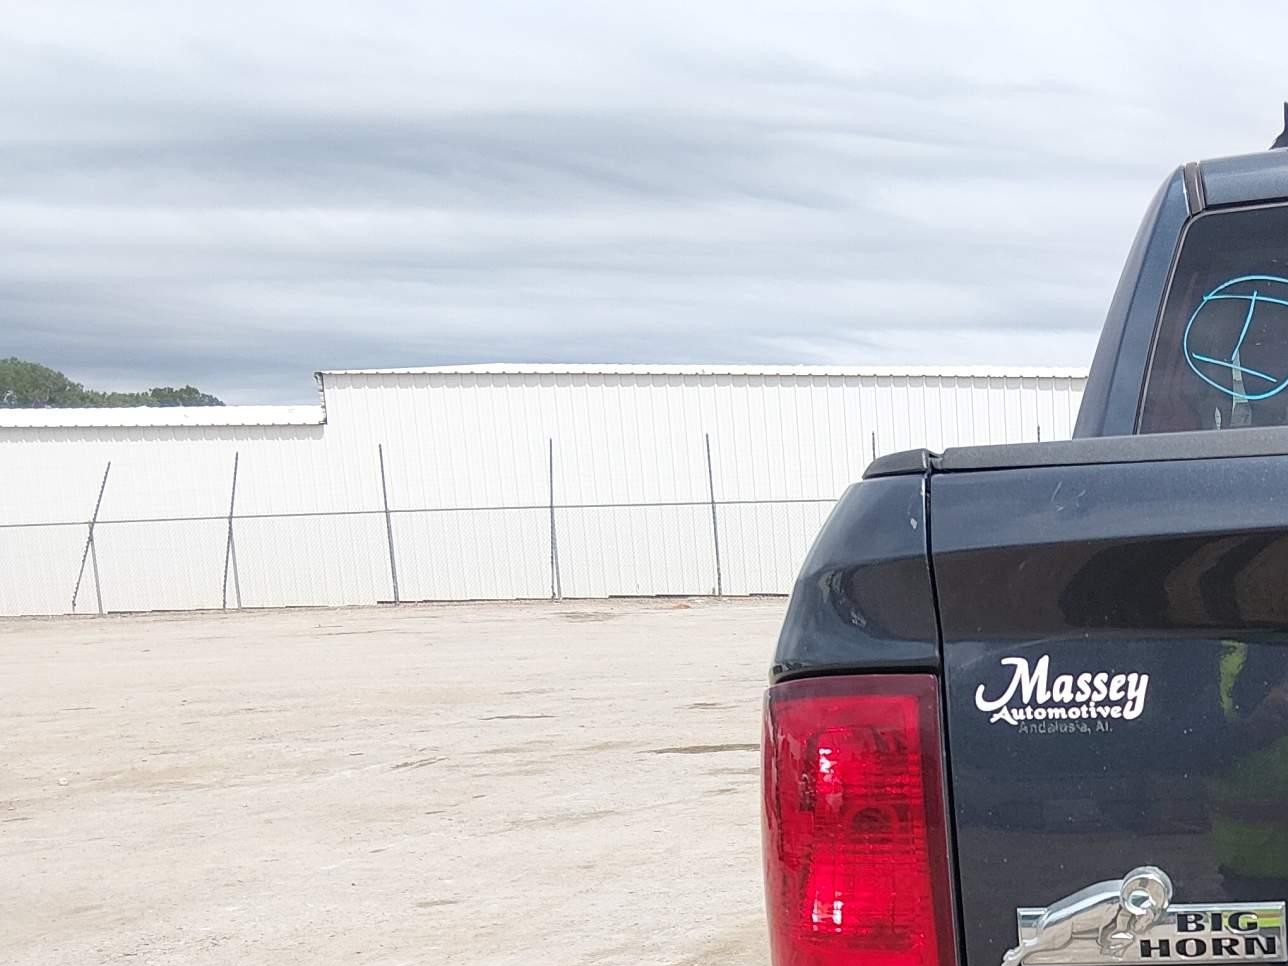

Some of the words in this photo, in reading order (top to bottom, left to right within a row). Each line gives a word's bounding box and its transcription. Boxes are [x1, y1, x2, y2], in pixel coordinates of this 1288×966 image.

[975, 654, 1149, 720] Massey
[990, 701, 1123, 725] Automotive
[1176, 911, 1259, 933] BIG
[1139, 937, 1277, 958] HORN
